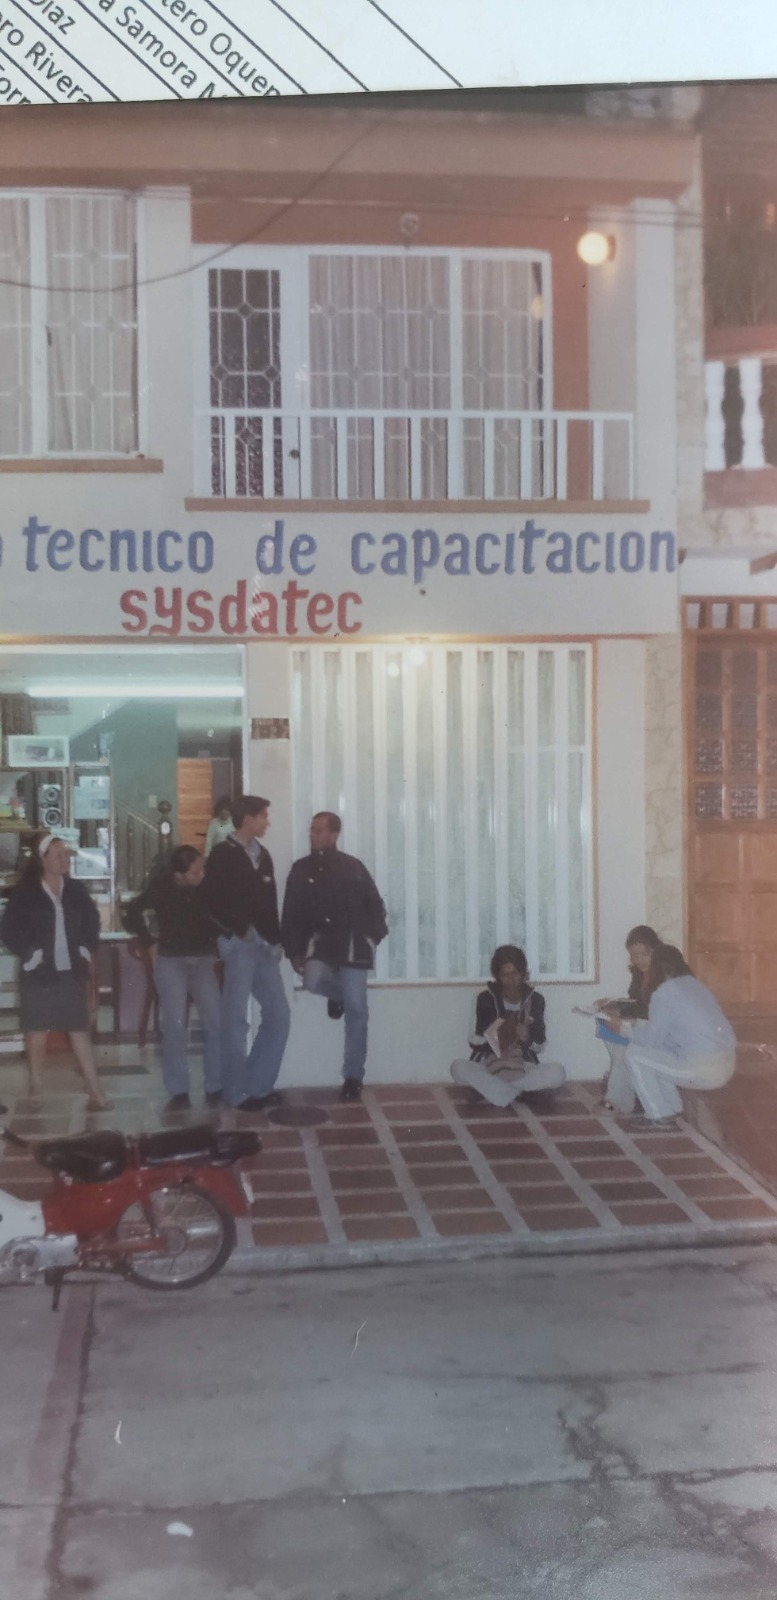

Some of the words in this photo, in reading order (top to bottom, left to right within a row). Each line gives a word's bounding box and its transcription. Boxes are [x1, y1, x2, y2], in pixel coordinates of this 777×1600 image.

[115, 6, 198, 89] Samora
[22, 515, 215, 573] tecnico
[255, 519, 318, 576] de
[351, 519, 676, 585] capacitacion
[119, 579, 363, 636] sysdatec
